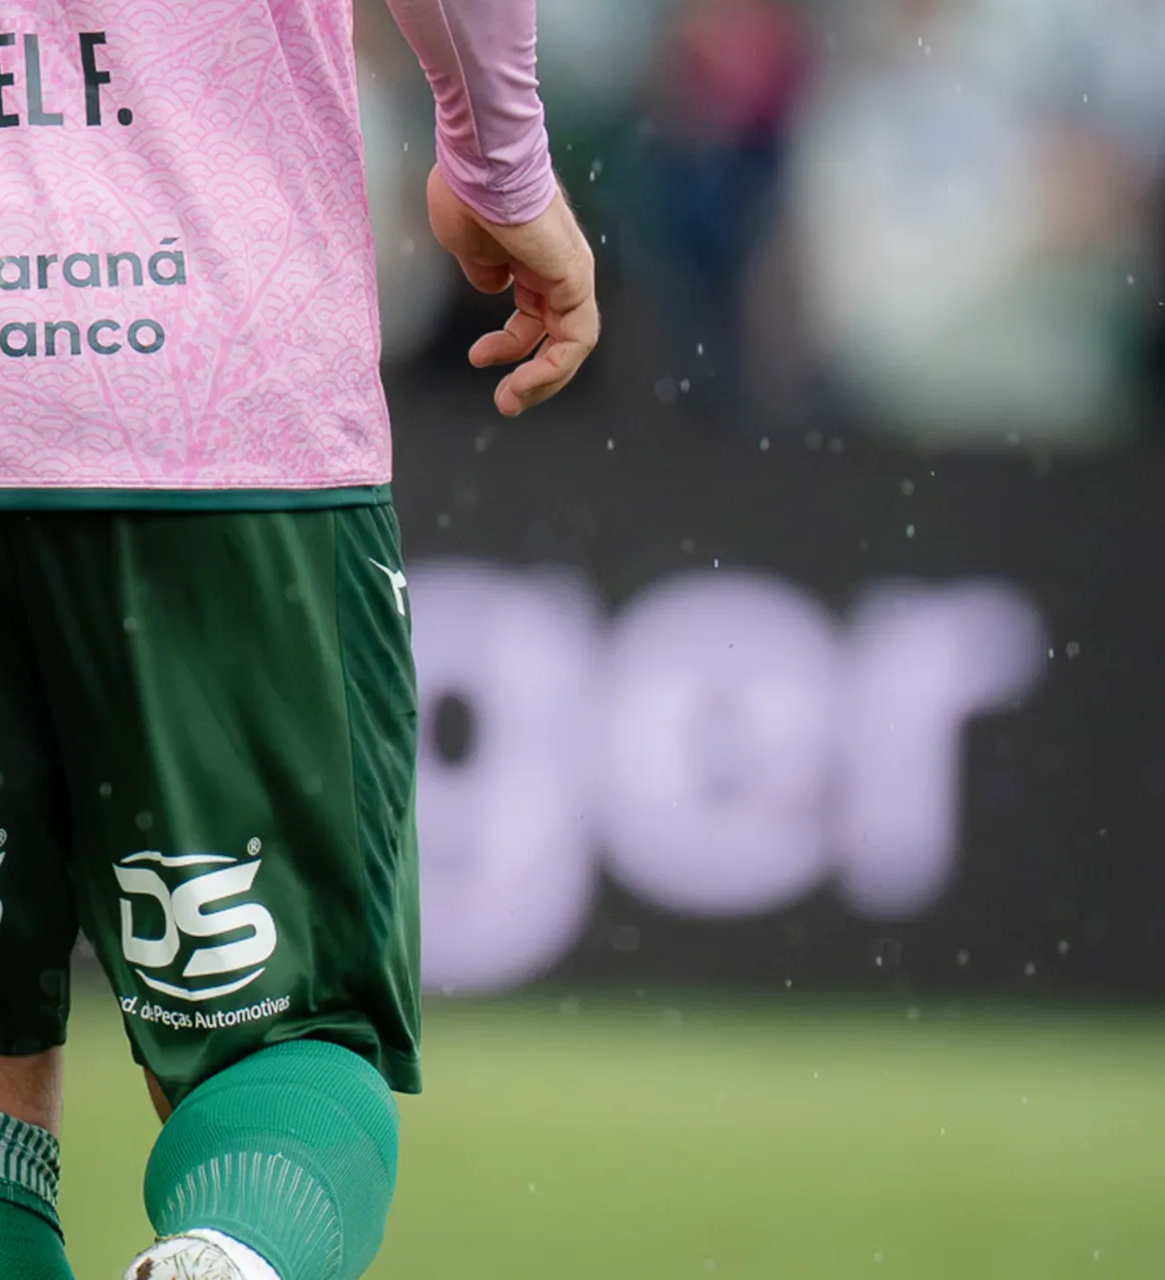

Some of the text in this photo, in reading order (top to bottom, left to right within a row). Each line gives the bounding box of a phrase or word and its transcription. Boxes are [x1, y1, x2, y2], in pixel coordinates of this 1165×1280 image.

[79, 31, 134, 127] F.
[112, 858, 277, 978] DS
[154, 1004, 193, 1030] Peças
[195, 995, 291, 1029] Automotivas
